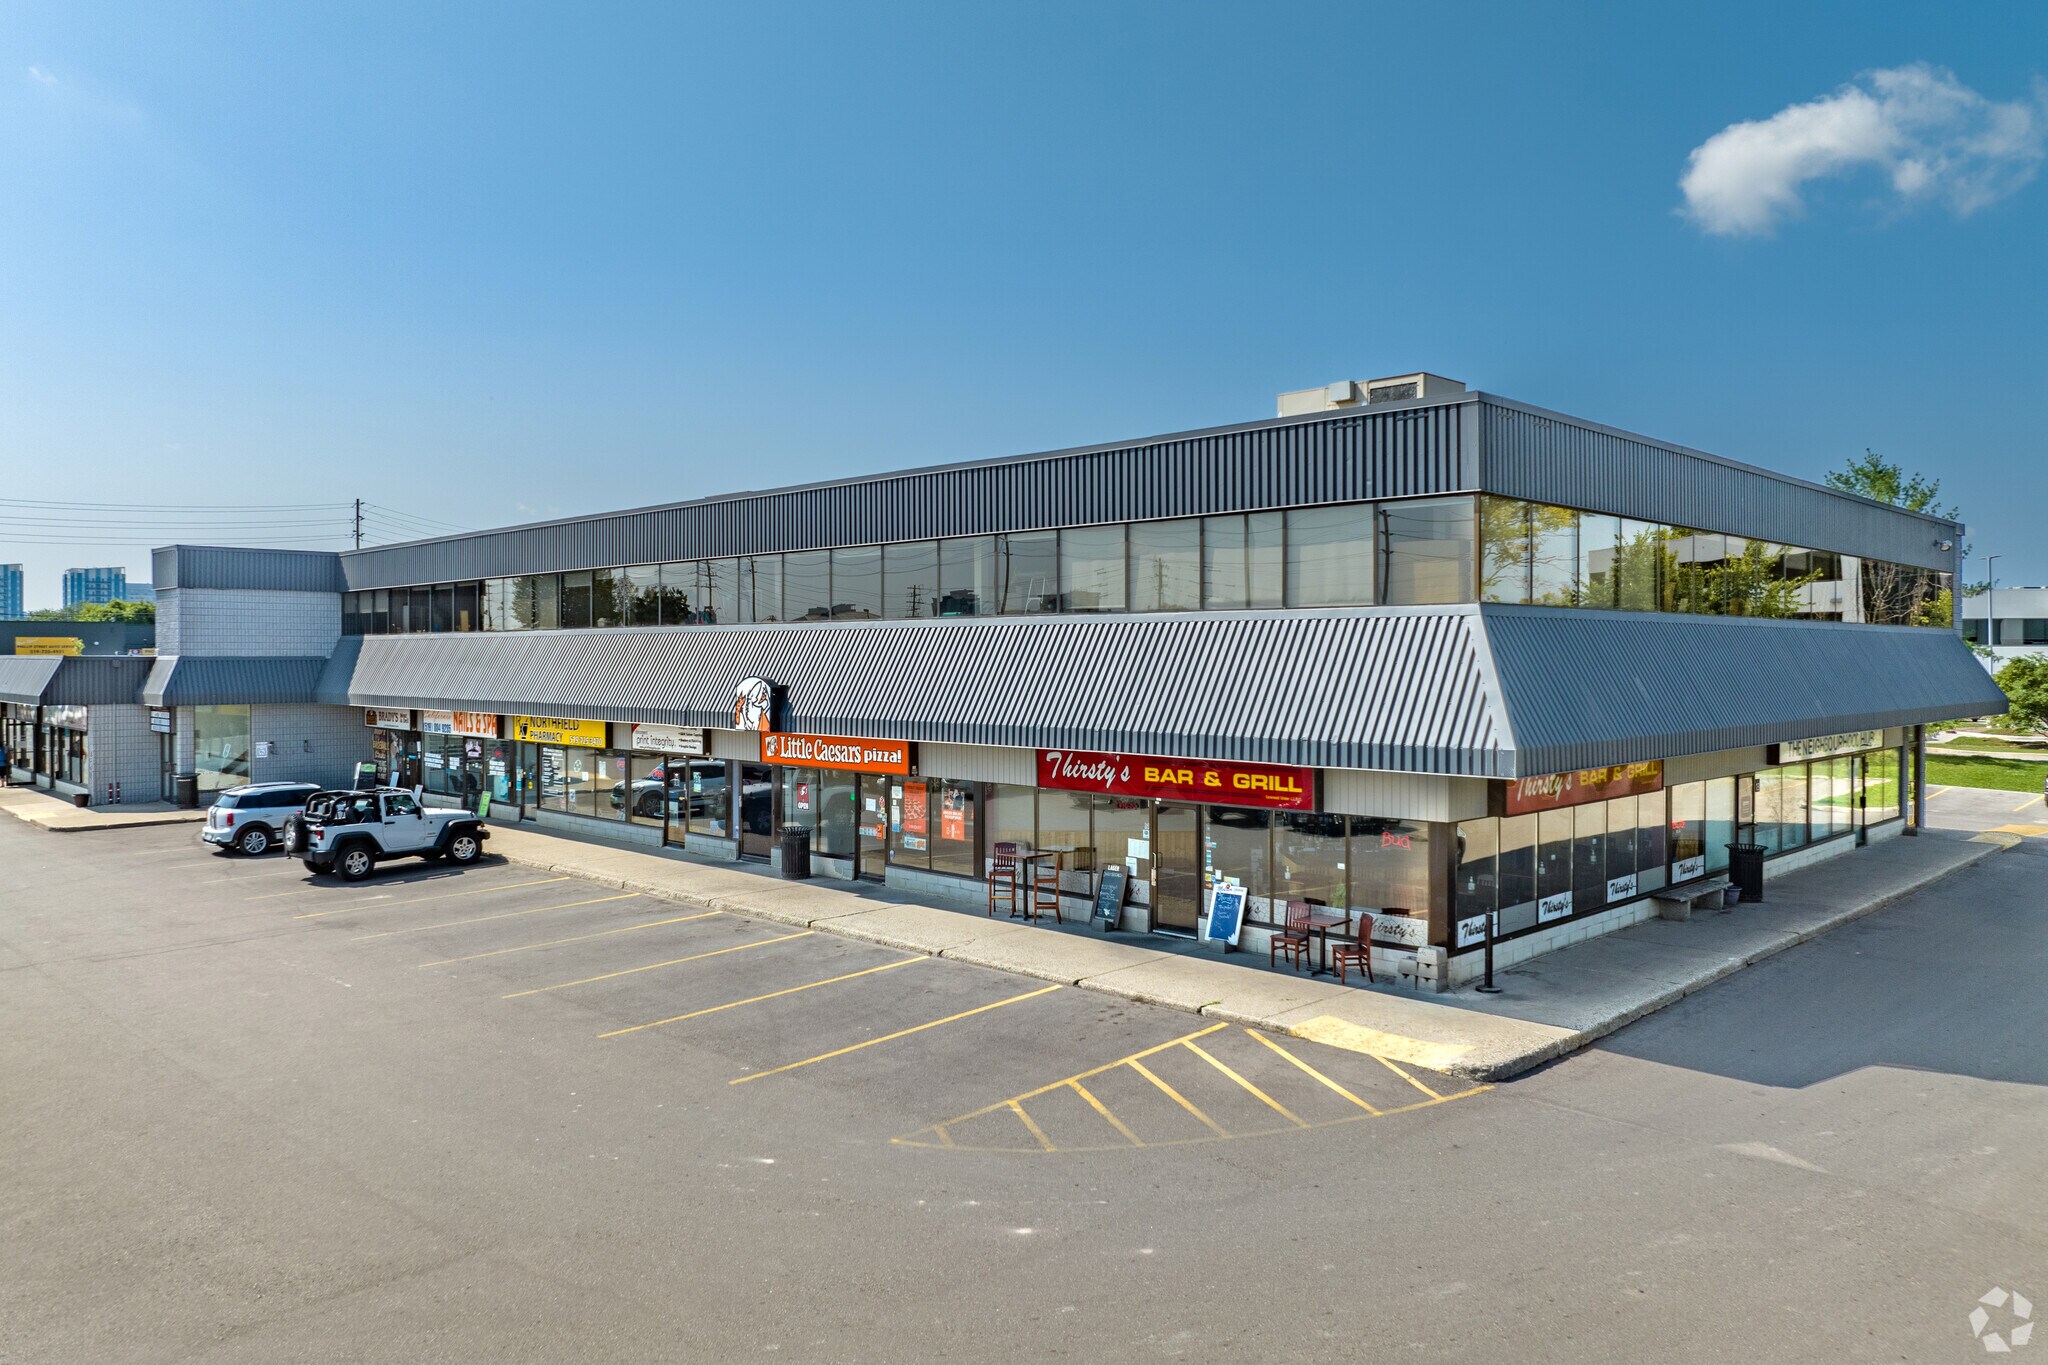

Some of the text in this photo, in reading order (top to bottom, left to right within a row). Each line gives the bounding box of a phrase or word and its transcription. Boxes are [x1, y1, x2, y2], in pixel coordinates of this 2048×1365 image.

[378, 711, 399, 722] BRADY'S
[453, 711, 497, 736] NAILS & SPA
[530, 716, 580, 731] NORTHFIELD
[530, 730, 564, 743] PHARMACY
[636, 735, 650, 747] print
[780, 736, 902, 763] Little Caesars pizza!
[1788, 741, 1801, 757] THE
[1046, 752, 1303, 793] Thirsty's BAR & GRILL
[1517, 761, 1659, 801] Thirsty's BAR & GRILL
[1381, 831, 1411, 849] Bud
[1680, 859, 1699, 876] Thirsty's
[1611, 878, 1634, 897] Thirsty's
[1542, 898, 1571, 917] Thirsty's
